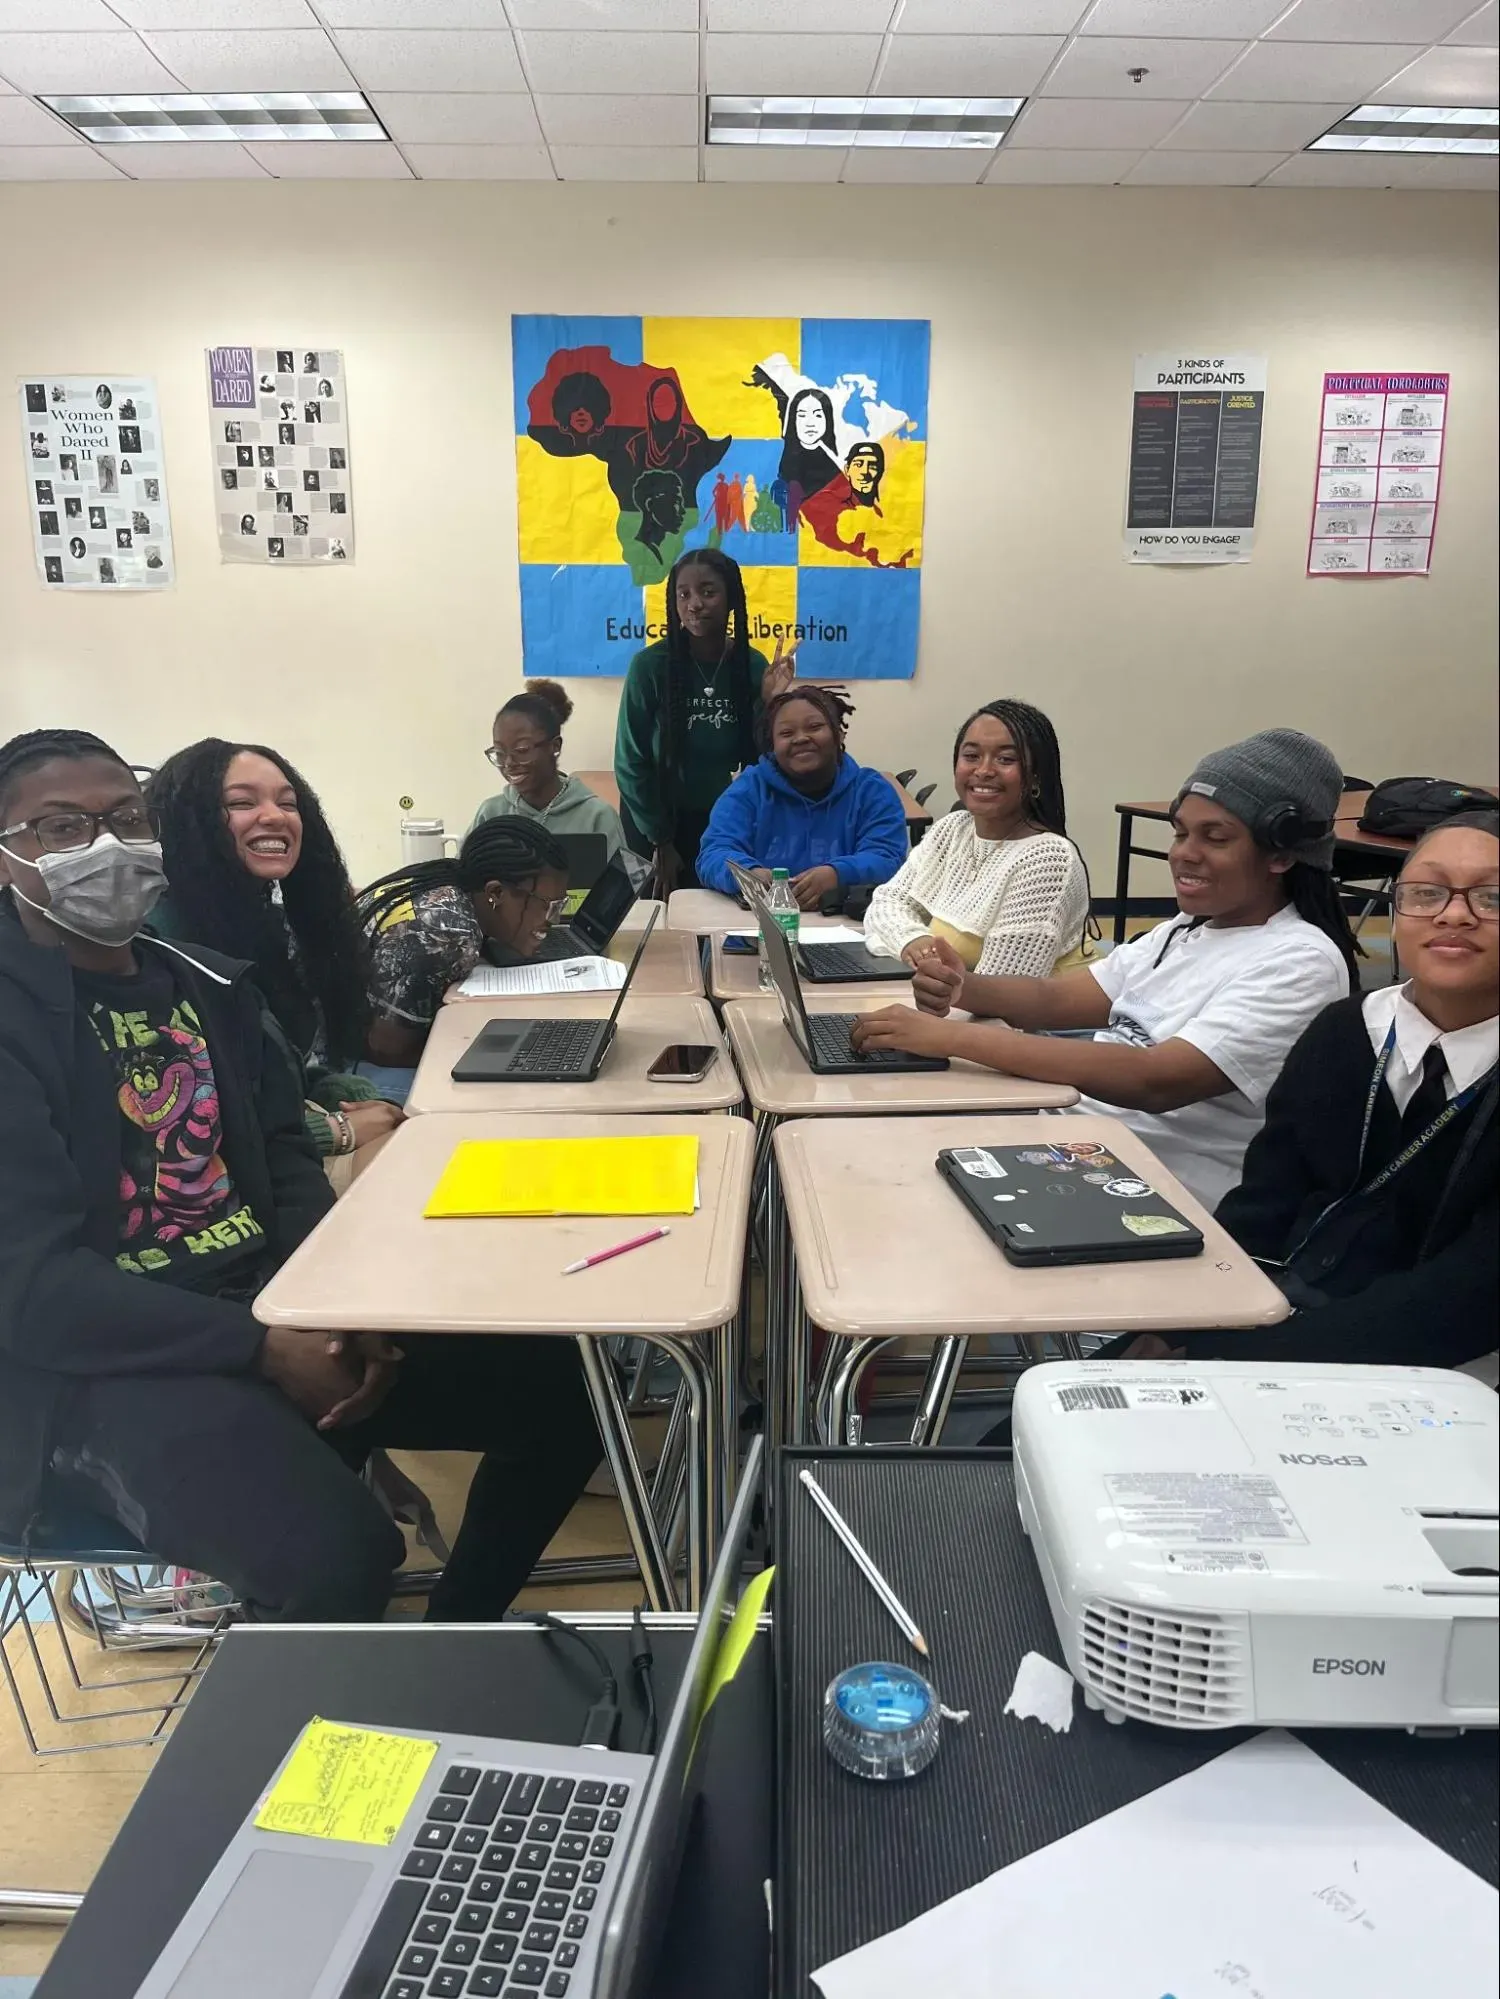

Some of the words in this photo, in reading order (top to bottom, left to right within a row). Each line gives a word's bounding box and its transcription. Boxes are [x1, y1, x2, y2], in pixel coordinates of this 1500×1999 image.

[210, 349, 251, 373] WOMEN
[1177, 359, 1182, 368] 3
[1184, 359, 1211, 368] KINDS
[1212, 359, 1225, 368] OF
[1157, 372, 1246, 385] PARTICIPANTS
[214, 379, 252, 402] DARED
[51, 409, 113, 420] Women
[64, 422, 103, 434] Who
[60, 436, 109, 447] Dared
[80, 449, 92, 460] II
[1139, 535, 1163, 544] HOW
[1165, 535, 1178, 544] DO
[1181, 535, 1200, 544] YOU
[1202, 535, 1241, 544] ENGAGE?
[606, 617, 668, 641] Educa
[1389, 1139, 1423, 1173] CAREER
[1420, 1103, 1460, 1144] ACADEMY
[1279, 1453, 1368, 1467] EPSON
[1312, 1658, 1386, 1676] EPSON
